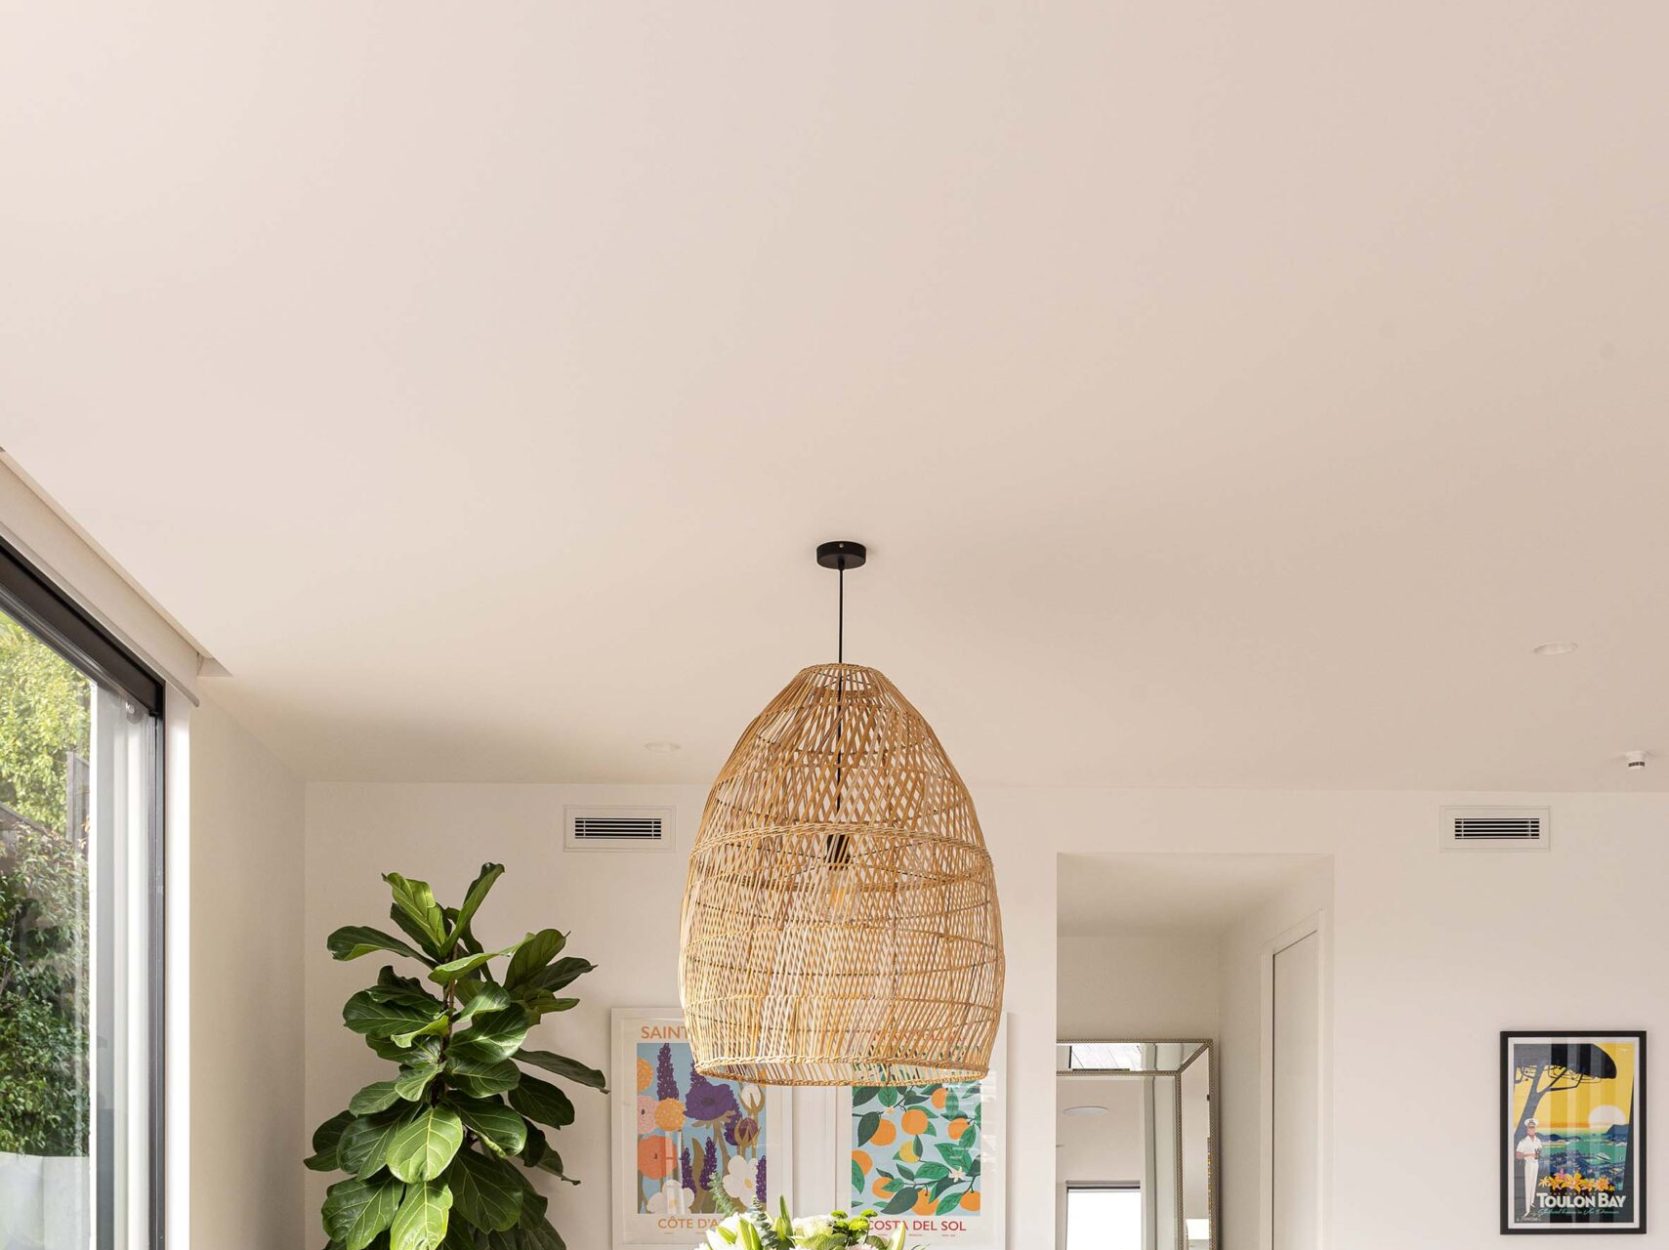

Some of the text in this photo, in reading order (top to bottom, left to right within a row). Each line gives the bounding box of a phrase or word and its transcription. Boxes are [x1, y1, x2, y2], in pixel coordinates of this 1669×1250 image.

[1536, 1192, 1626, 1208] TOULON BAY
[658, 1216, 693, 1229] CÔTE
[913, 1220, 937, 1231] DEL
[941, 1220, 966, 1231] SOL
